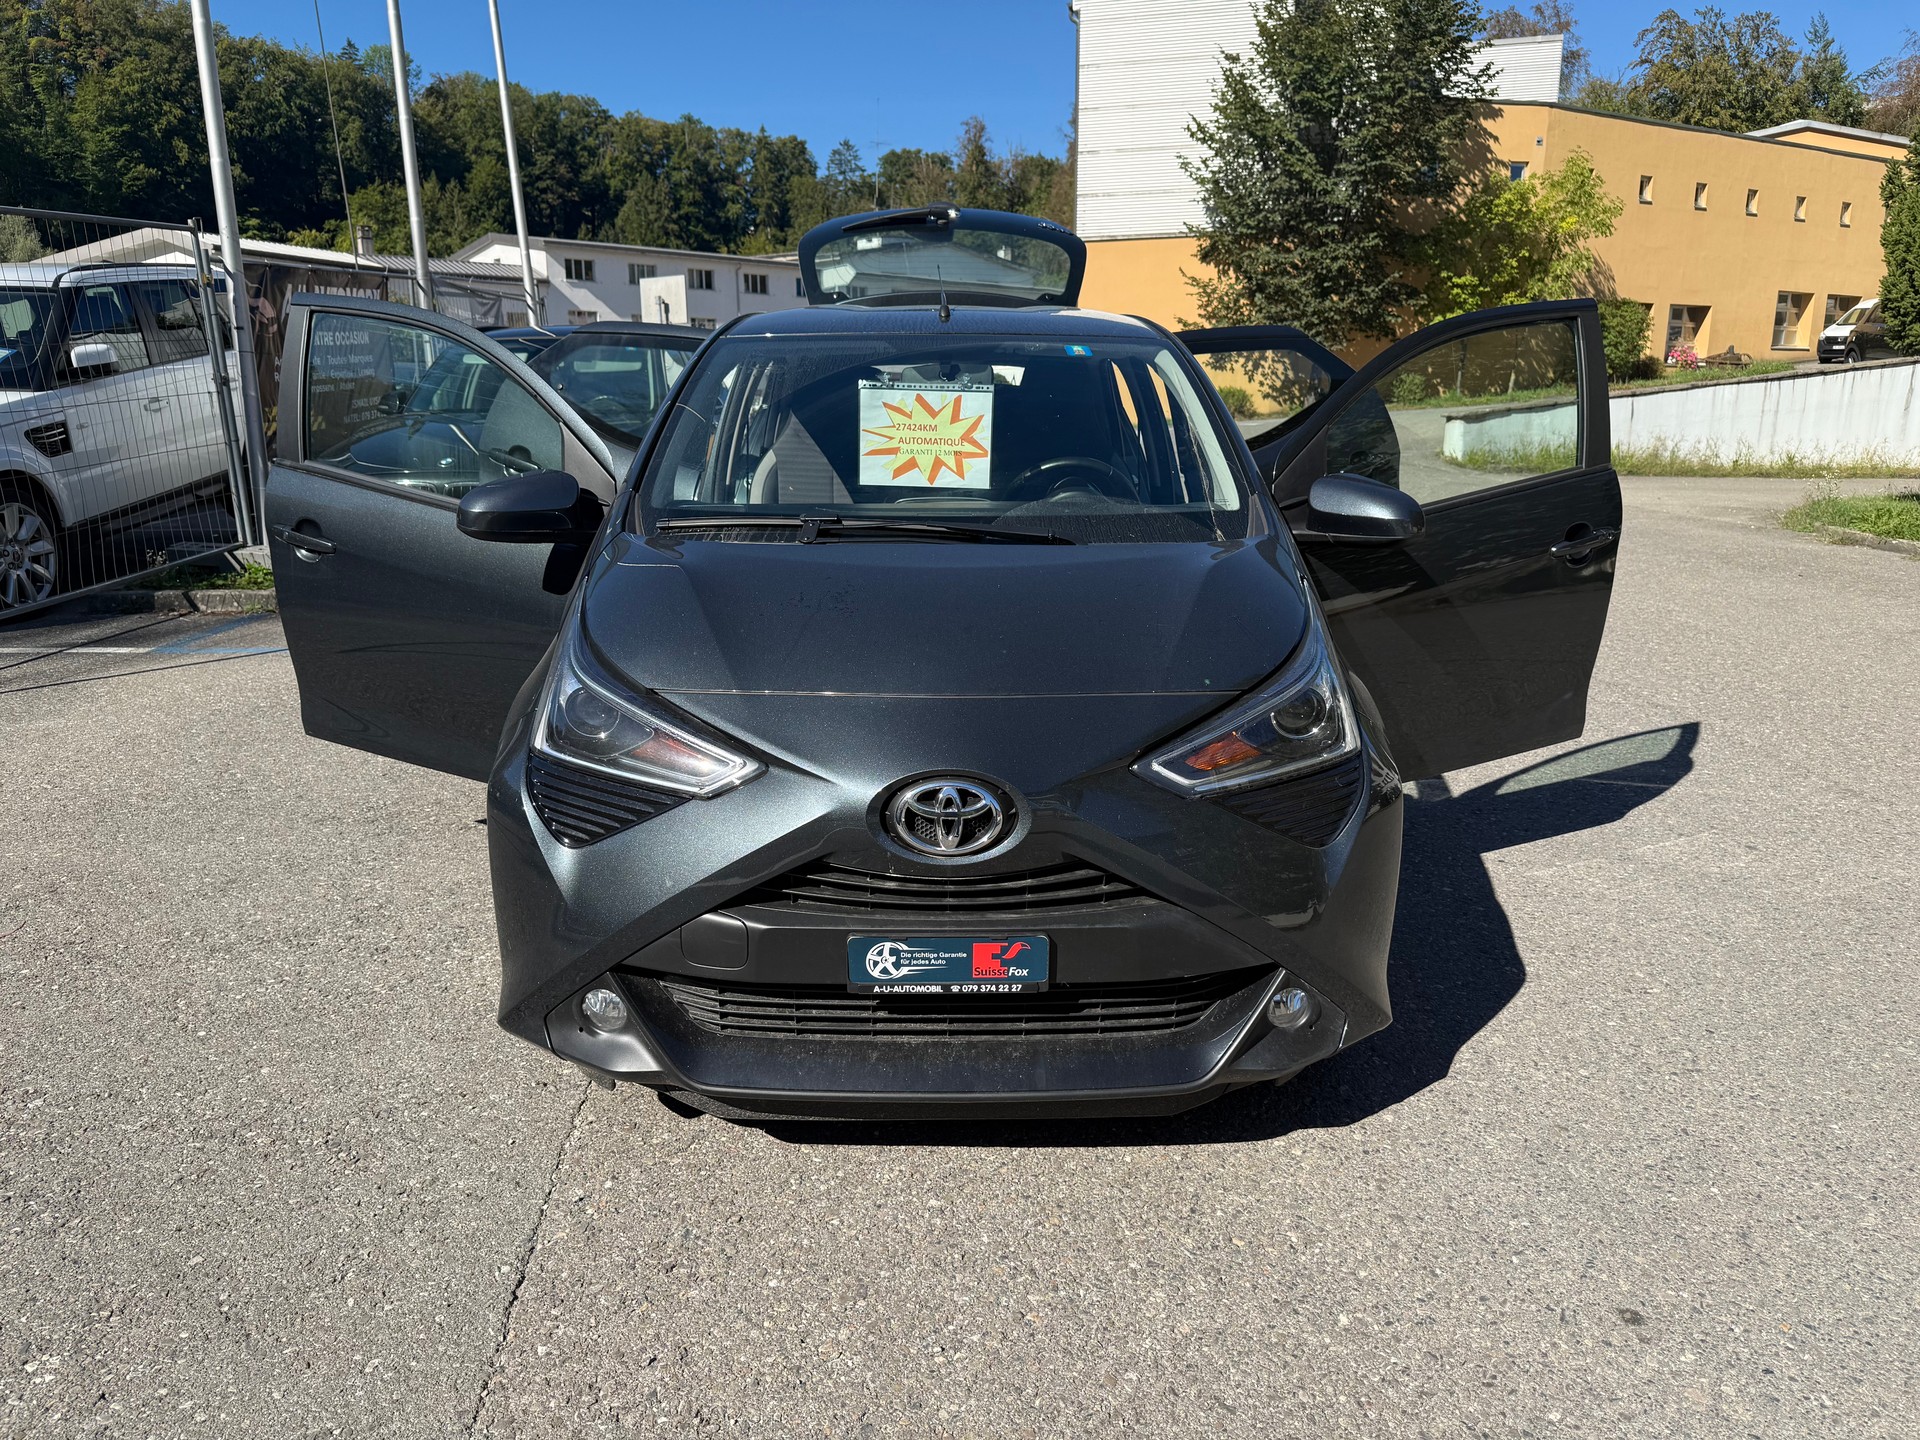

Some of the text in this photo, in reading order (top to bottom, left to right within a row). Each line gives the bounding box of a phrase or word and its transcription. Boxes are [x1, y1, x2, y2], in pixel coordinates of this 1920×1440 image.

[335, 331, 370, 345] OCCASION
[896, 423, 938, 432] 27424KM
[898, 436, 965, 447] AUTOMATIQUE
[899, 448, 933, 456] GARANTI
[873, 985, 943, 993] A-U-AUTOMOBIL
[1011, 984, 1022, 992] 27
